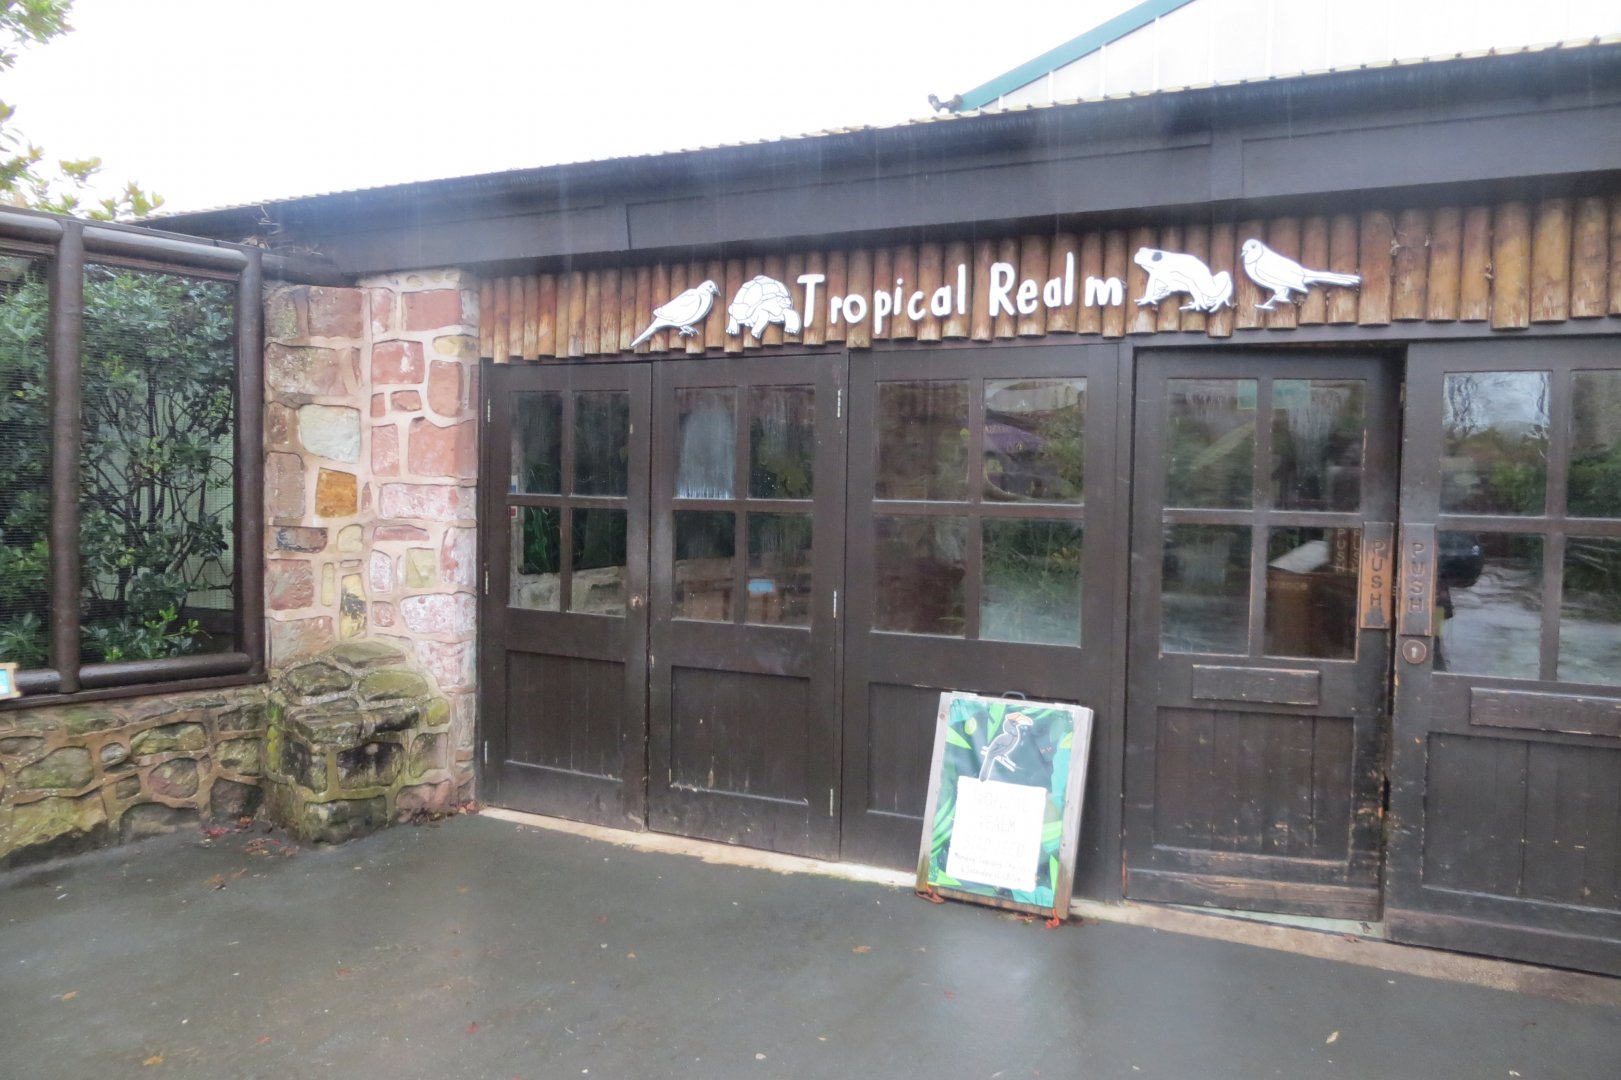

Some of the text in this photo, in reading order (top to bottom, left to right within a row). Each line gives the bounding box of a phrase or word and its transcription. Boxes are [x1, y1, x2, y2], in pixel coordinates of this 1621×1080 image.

[797, 252, 1123, 335] Tropical Realm
[1370, 539, 1386, 607] PUSH
[1408, 542, 1425, 613] PUSH
